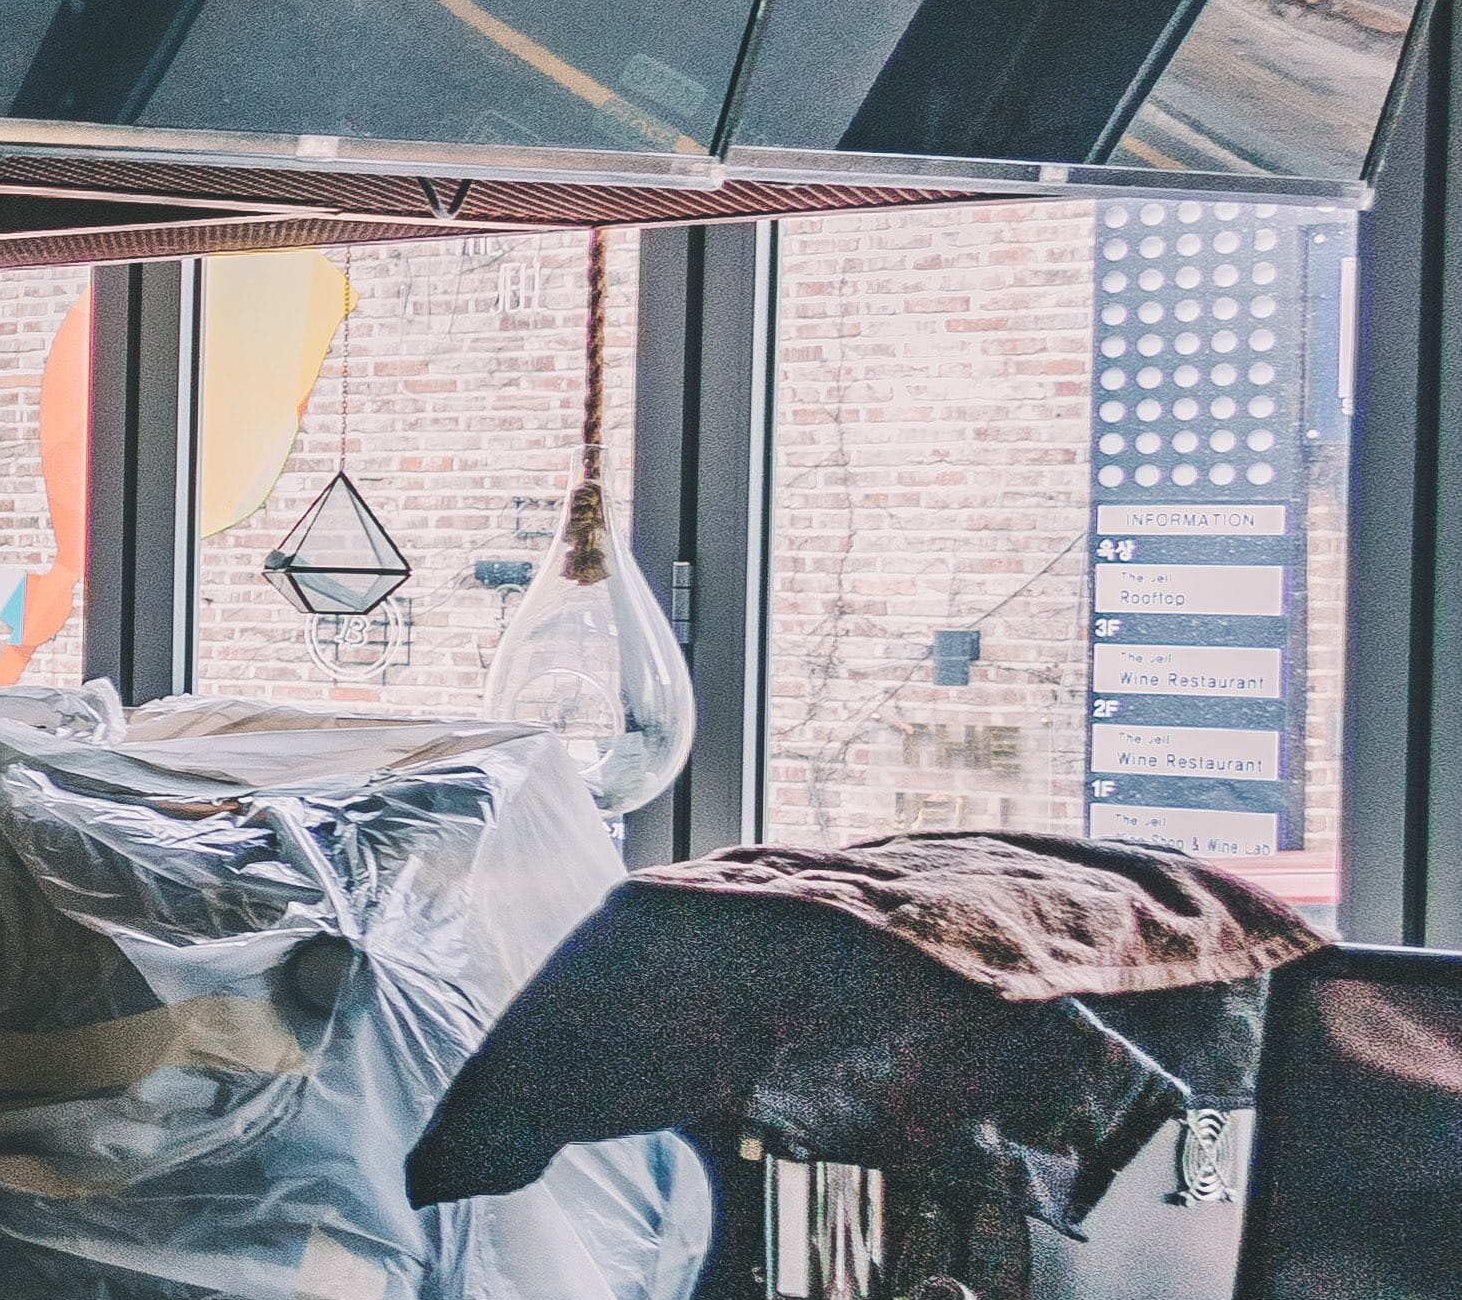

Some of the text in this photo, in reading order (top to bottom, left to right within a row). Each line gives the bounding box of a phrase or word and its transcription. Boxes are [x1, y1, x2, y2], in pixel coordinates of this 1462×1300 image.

[1126, 513, 1255, 527] INFORMATION
[1097, 539, 1136, 561] 옥상
[1120, 590, 1186, 607] Rooftop
[1095, 619, 1122, 637] 3F
[1120, 672, 1265, 690] Wine Restaurant
[1093, 700, 1119, 717] 2F
[1117, 752, 1263, 772] Wine Restaurant
[1091, 780, 1116, 797] 1F
[1192, 837, 1200, 851] &
[1208, 839, 1238, 854] Wine
